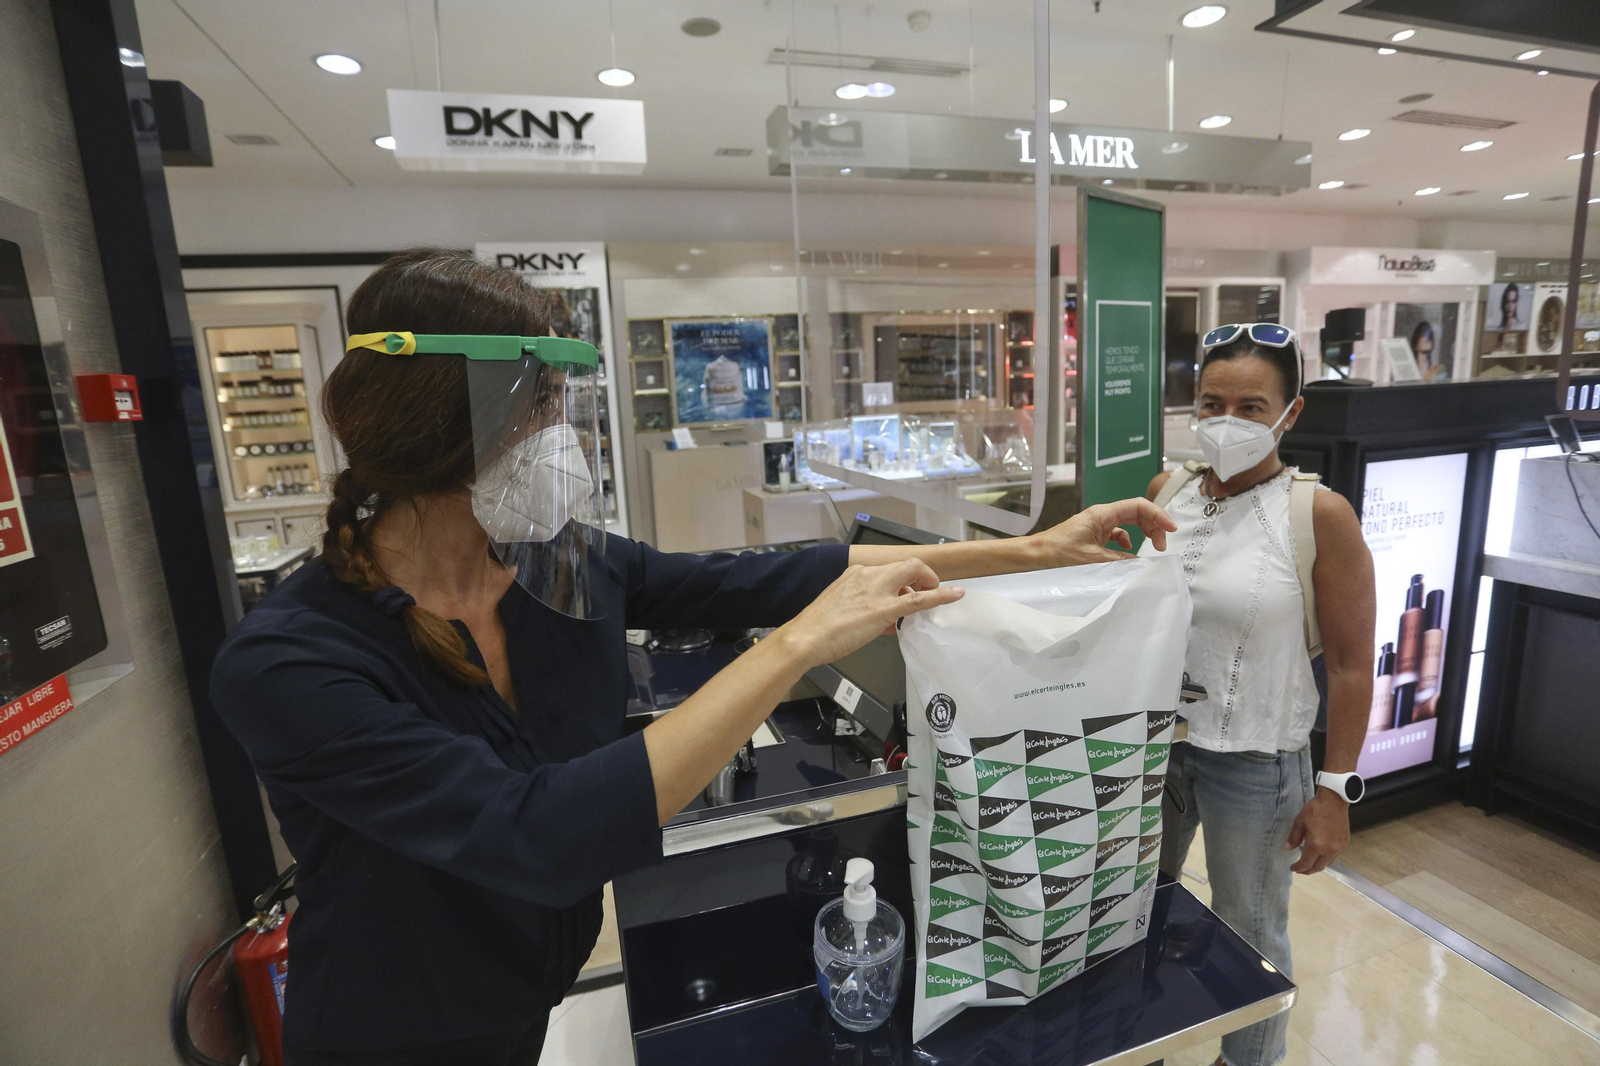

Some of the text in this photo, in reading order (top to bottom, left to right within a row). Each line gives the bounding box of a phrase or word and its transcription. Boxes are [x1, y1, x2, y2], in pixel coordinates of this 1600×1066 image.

[442, 105, 595, 140] DKNY
[445, 137, 489, 147] DONNA
[493, 140, 534, 149] KARAN
[1068, 133, 1139, 169] MER
[496, 253, 585, 271] DKNY
[1363, 487, 1384, 502] PIEL
[1362, 500, 1409, 519] NATURAL
[1392, 511, 1444, 531] PERFECTO
[40, 618, 67, 636] TECSAN
[27, 683, 55, 707] LIBRE
[1013, 681, 1086, 700] www.elcorteingles.es
[0, 698, 73, 753] STO MANGUERA
[1025, 735, 1068, 749] El Corte Inglés
[1088, 745, 1136, 759] El Corte Inglés
[977, 764, 1012, 780] El Corte Inglés
[1027, 771, 1074, 785] El Corte Inglés
[1095, 778, 1134, 795] El Corte Inglés
[980, 800, 1018, 817] El Corte Inglés
[1033, 807, 1081, 821] El Corte Inglés
[1098, 808, 1130, 829] El Corte Inglés
[938, 825, 955, 836] Corte
[979, 838, 1024, 853] El Corte Inglés
[1037, 845, 1086, 858] El Corte Inglés
[931, 860, 975, 873] El Corte Inglés
[1004, 874, 1028, 887] Inglés
[1043, 885, 1051, 895] El
[1050, 884, 1068, 894] Corte
[931, 896, 970, 909] El Corte Inglés
[1004, 904, 1029, 917] Inglés
[1091, 896, 1122, 917] El Corte Inglés
[984, 916, 993, 925] El
[1044, 905, 1081, 928] El Corte Inglés
[927, 933, 972, 947] El Corte Inglés
[1088, 923, 1120, 945] El Corte Inglés
[1042, 934, 1079, 956] El Corte Inglés
[984, 952, 1026, 972] El Corte Inglés
[1039, 961, 1075, 984] El Corte Inglés
[926, 974, 973, 988] El Corte Inglés
